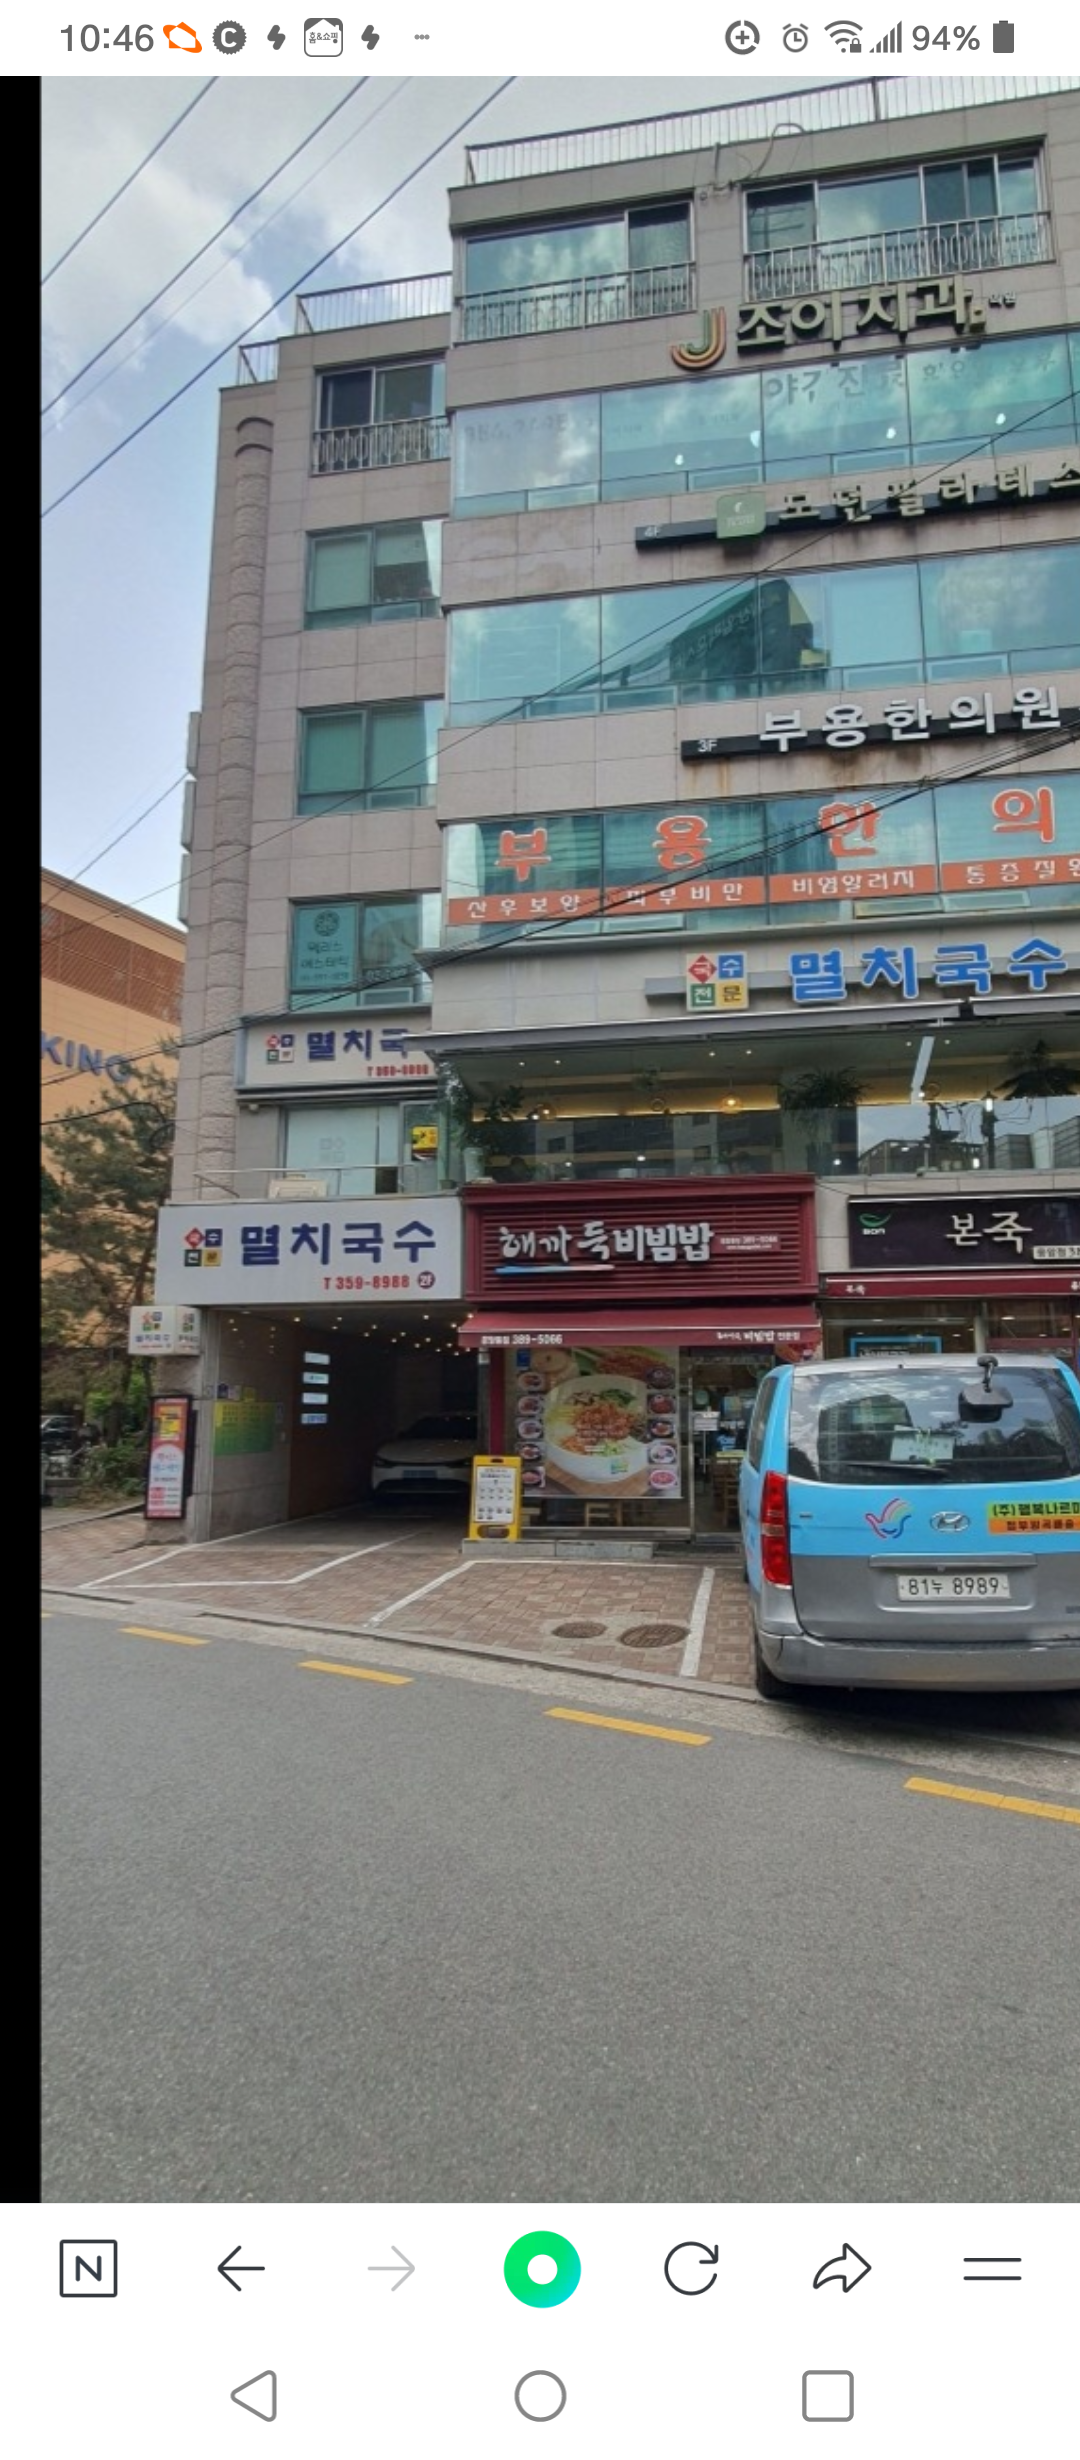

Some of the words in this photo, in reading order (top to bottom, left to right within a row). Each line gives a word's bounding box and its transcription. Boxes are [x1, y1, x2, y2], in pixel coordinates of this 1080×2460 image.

[760, 686, 1061, 751] 부용한의원
[697, 737, 717, 753] 3F
[792, 871, 915, 896] 비염알러지
[788, 937, 1068, 1002] 멸치국수
[241, 1220, 436, 1266] 멸치국수
[945, 1211, 1033, 1254] 본죽
[323, 1277, 331, 1290] T
[335, 1275, 410, 1290] 359-8988
[419, 1273, 433, 1288] 2F
[512, 1334, 562, 1345] 389-5066
[908, 1578, 943, 1596] 81누
[952, 1577, 999, 1595] 8989
